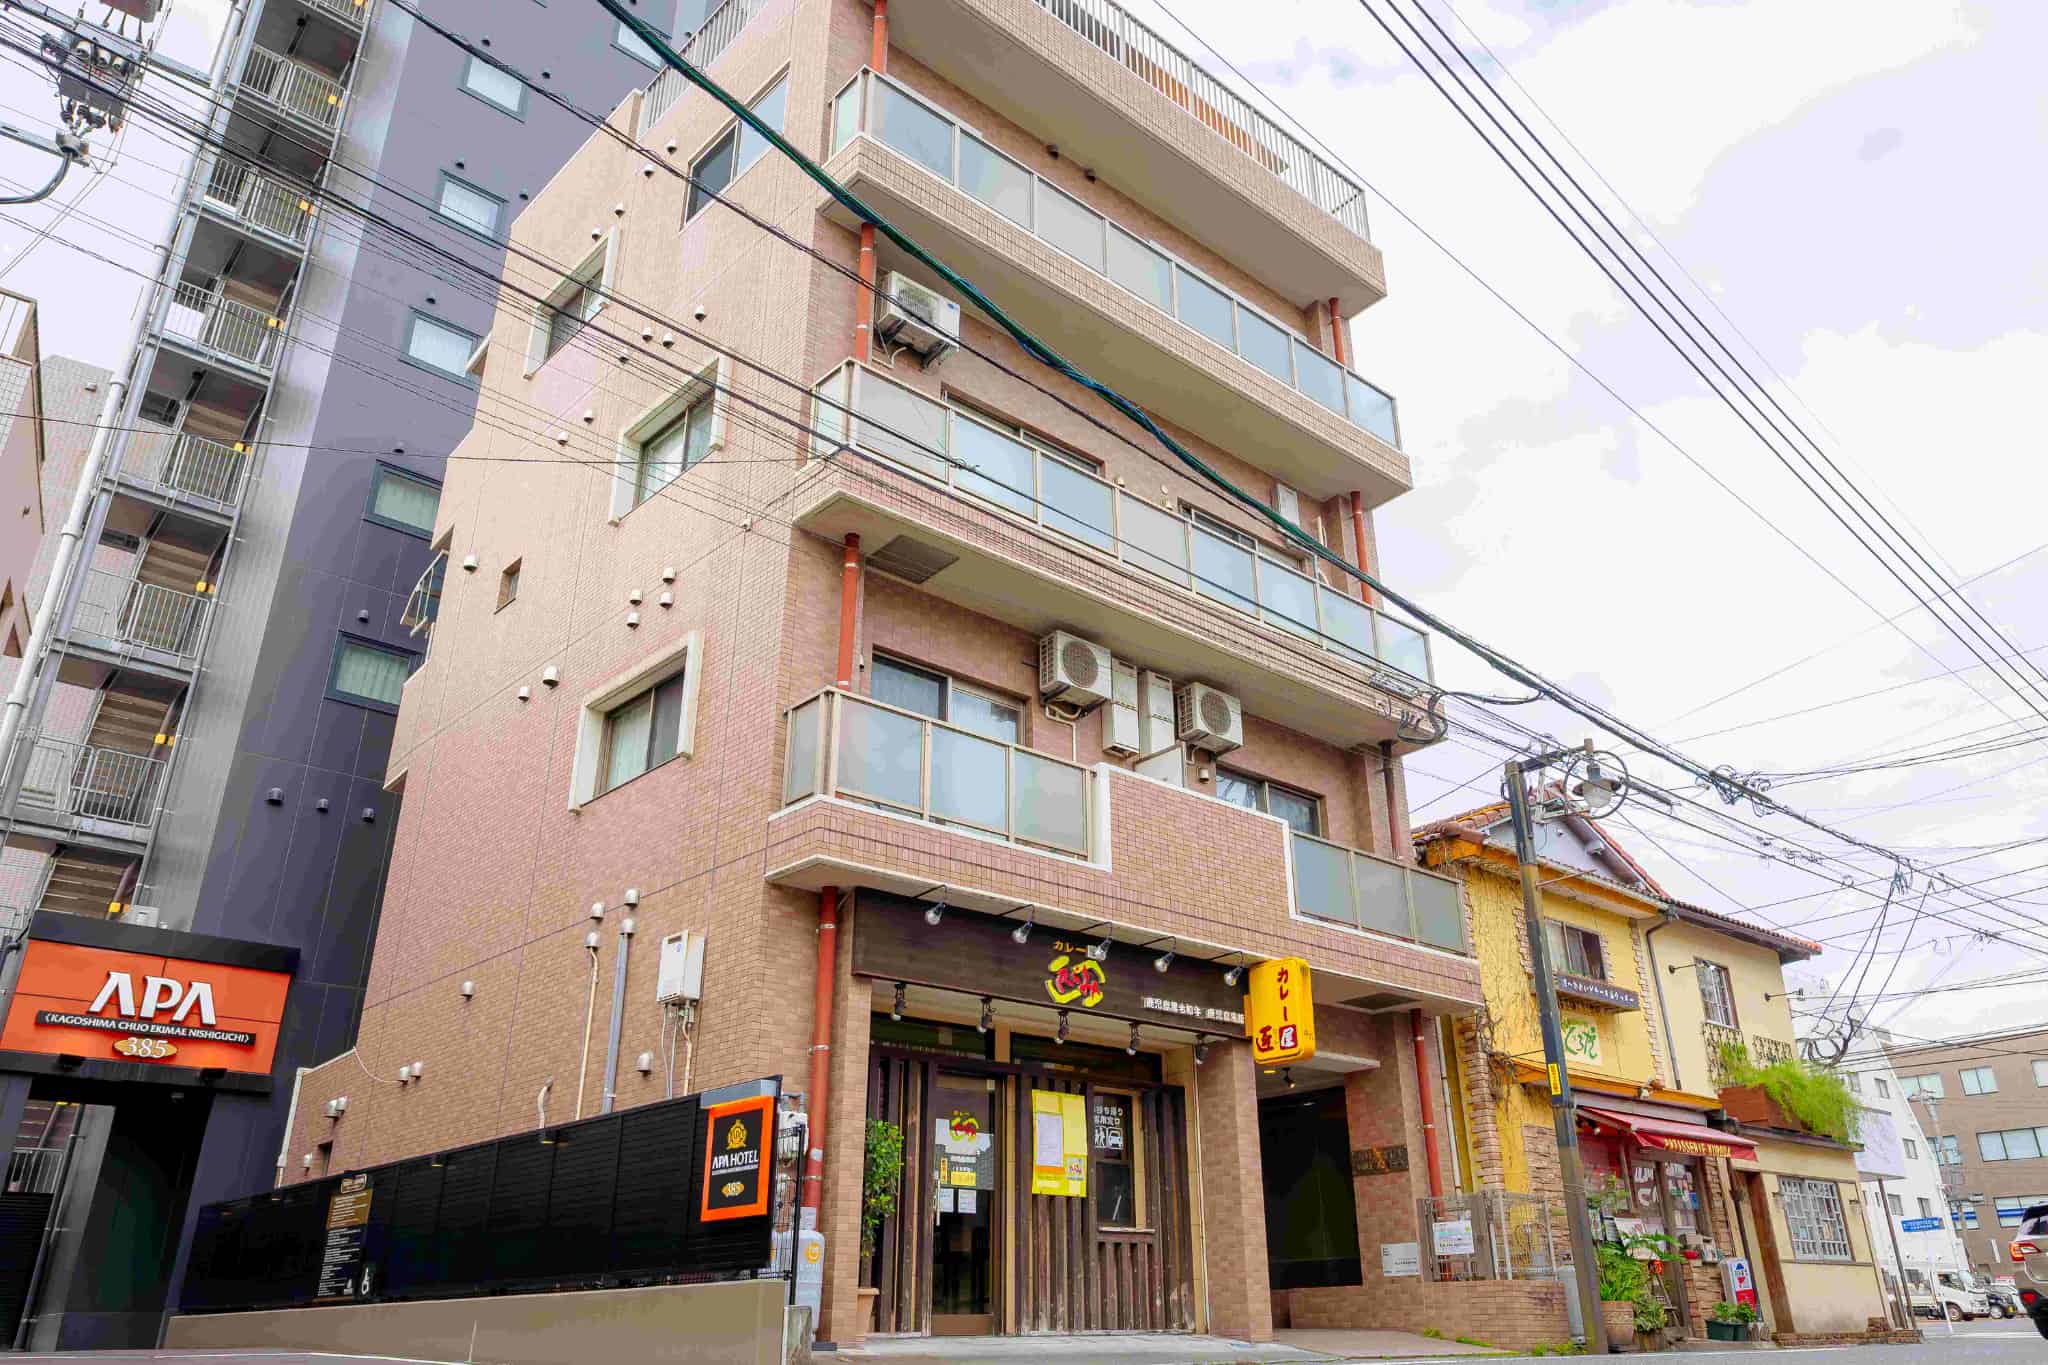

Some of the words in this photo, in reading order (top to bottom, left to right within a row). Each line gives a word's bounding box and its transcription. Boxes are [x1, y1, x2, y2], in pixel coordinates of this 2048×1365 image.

[87, 971, 216, 1025] APA
[118, 1021, 149, 1033] CHUO
[150, 1024, 186, 1037] EKIMAE
[123, 1036, 168, 1058] 385
[712, 1155, 729, 1169] APA
[730, 1150, 758, 1166] HOTEL
